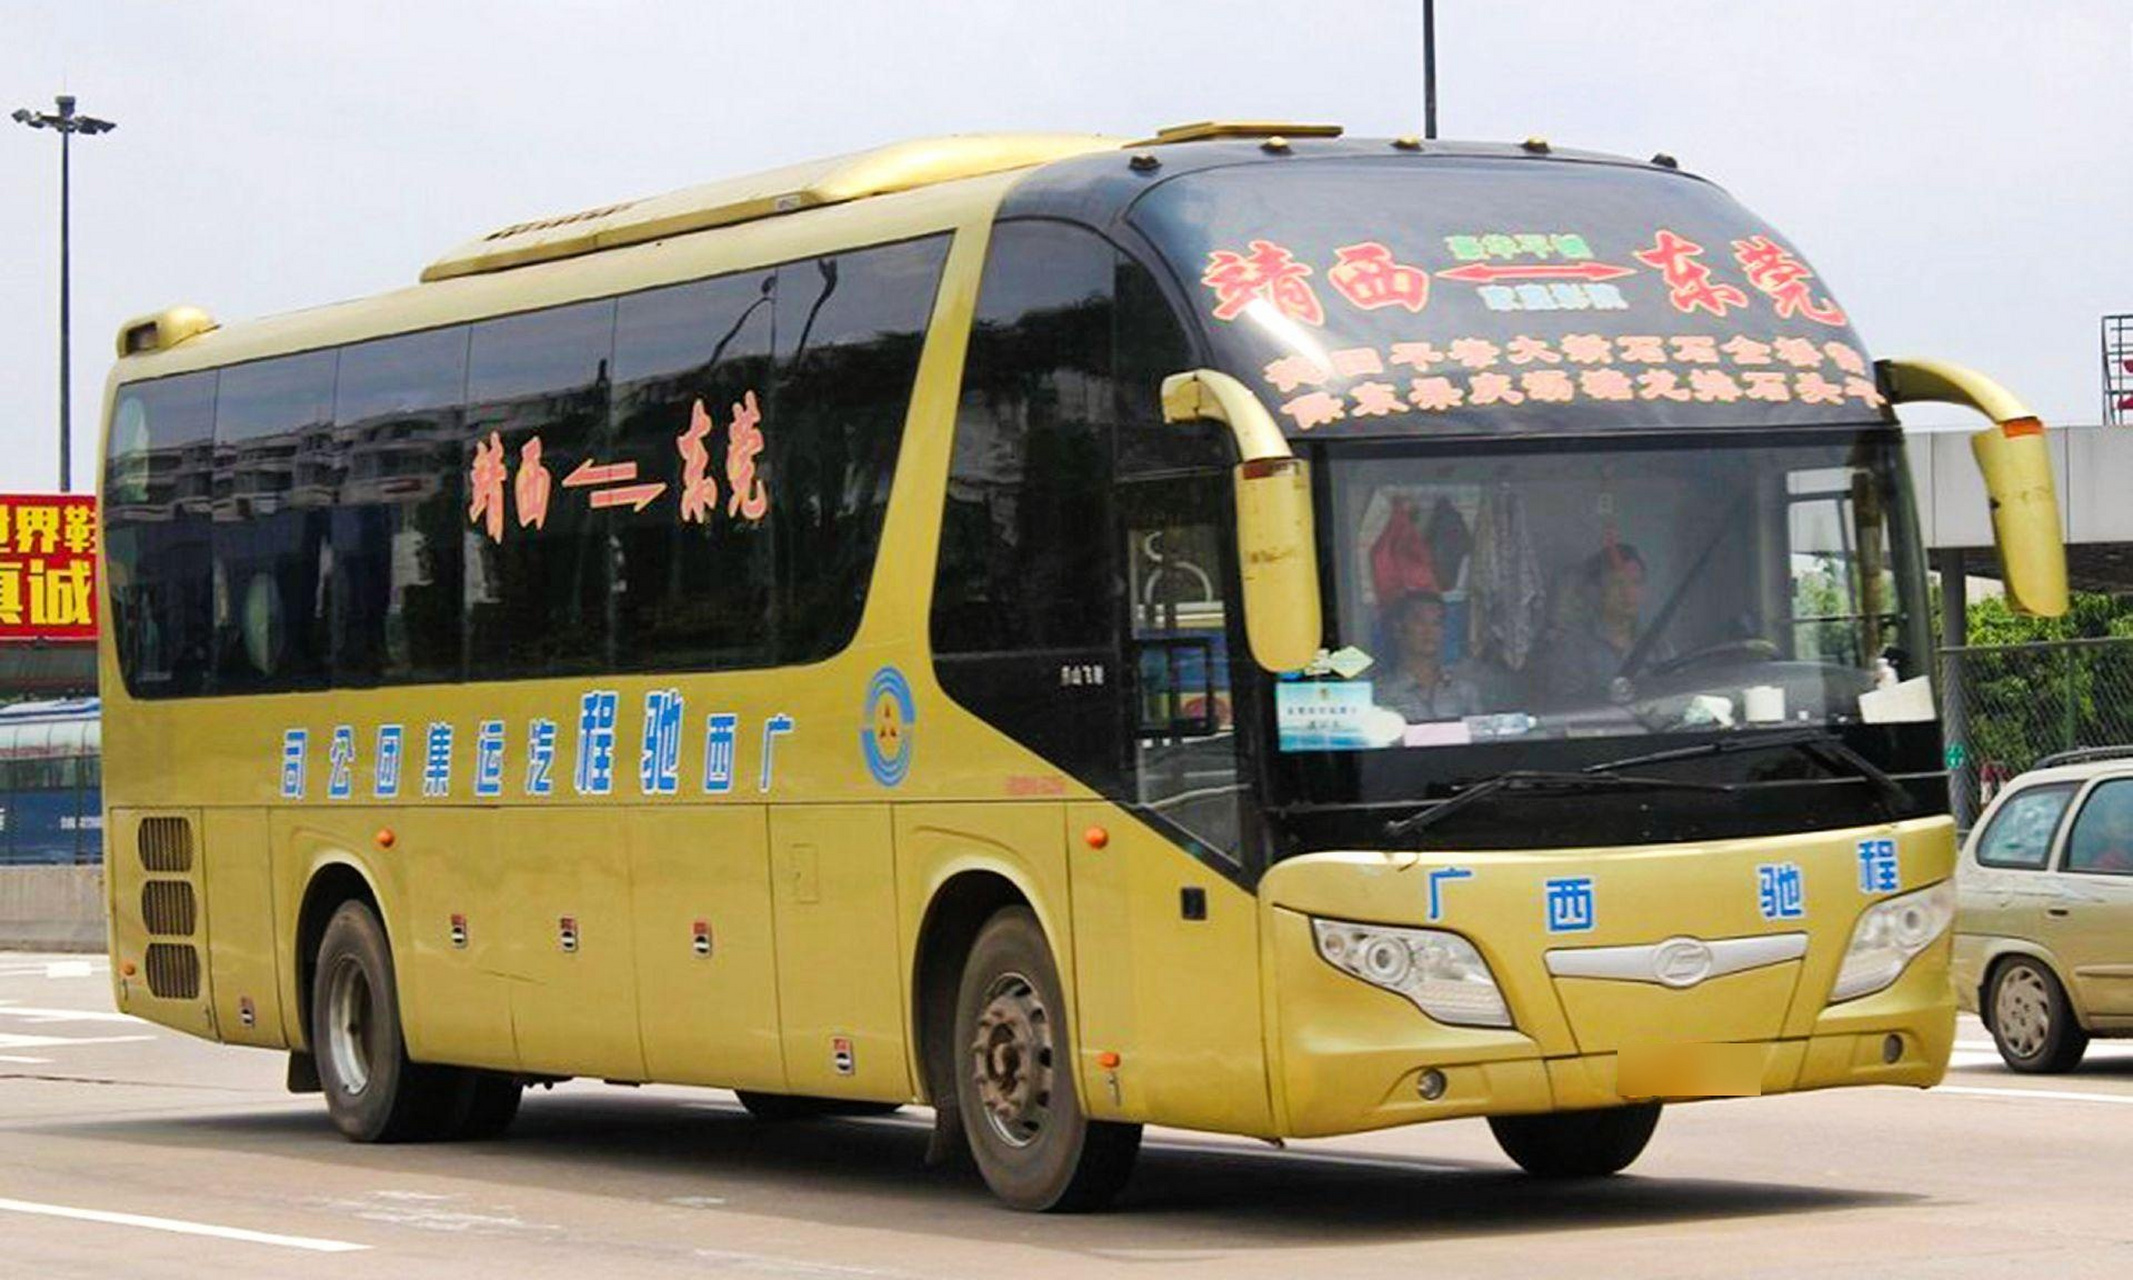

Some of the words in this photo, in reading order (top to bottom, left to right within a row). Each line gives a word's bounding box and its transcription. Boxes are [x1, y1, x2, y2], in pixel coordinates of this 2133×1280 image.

[1202, 238, 1430, 326] 靖西
[1634, 228, 1848, 327] 东莞
[468, 430, 551, 545] 靖西
[675, 389, 768, 526] 东莞
[0, 504, 96, 553] 界鞋
